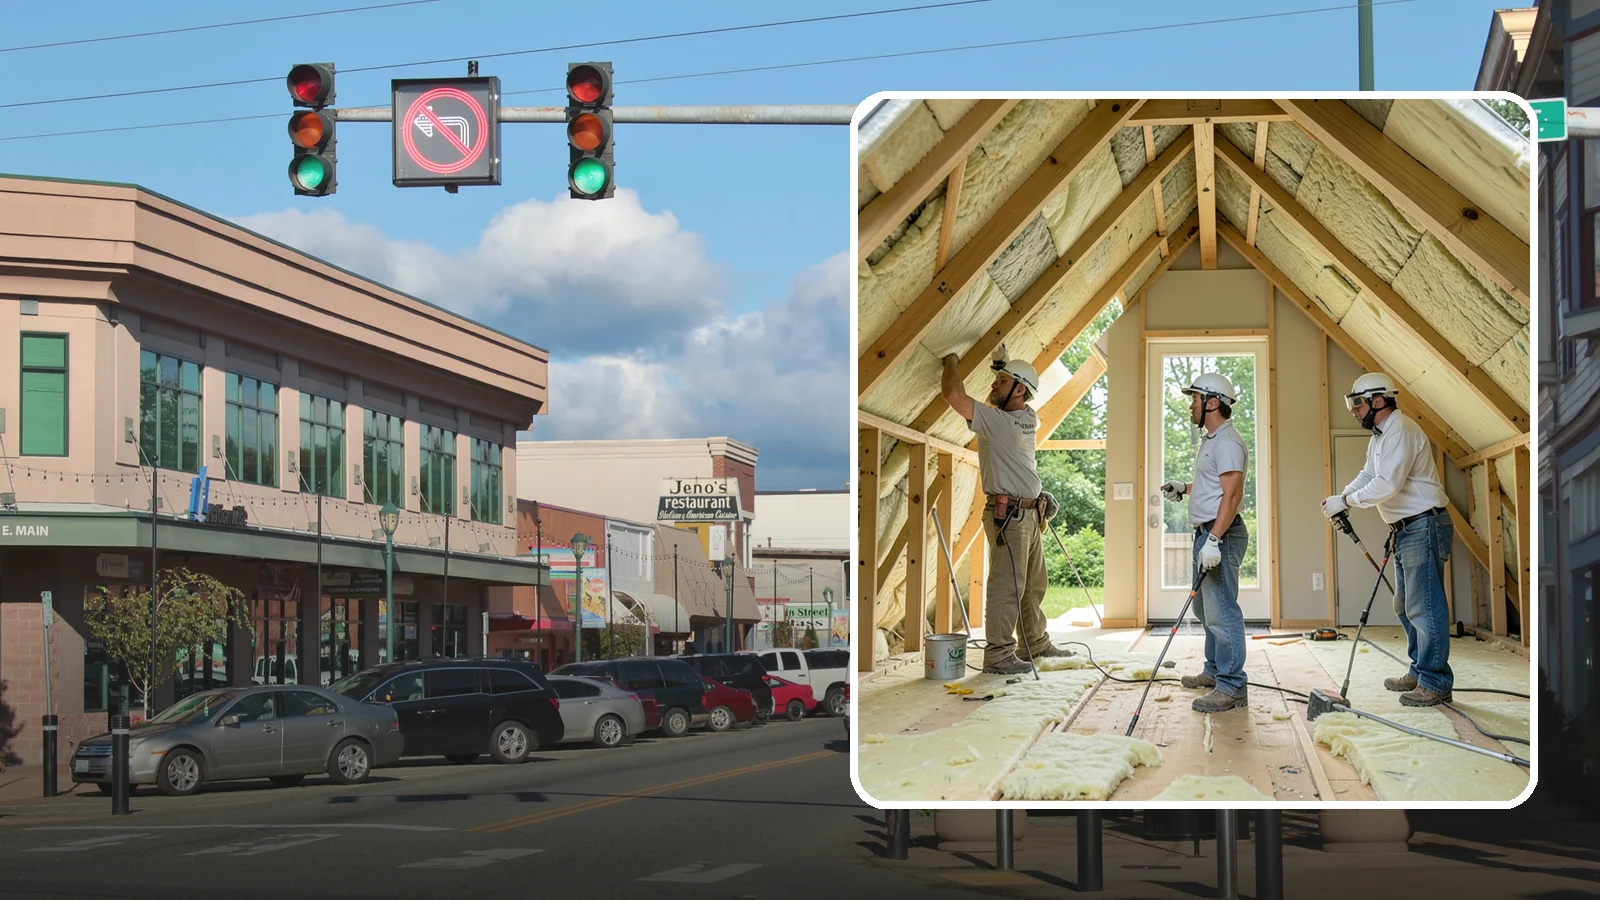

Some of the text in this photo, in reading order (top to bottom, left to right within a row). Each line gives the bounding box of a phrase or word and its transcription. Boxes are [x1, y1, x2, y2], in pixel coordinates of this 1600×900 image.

[670, 480, 728, 494] Jeno's
[665, 496, 731, 509] restaurant
[658, 509, 682, 519] Italian
[686, 510, 715, 519] American
[715, 509, 738, 519] Cuisine
[2, 525, 49, 536] E. MAIN
[797, 607, 828, 617] Street
